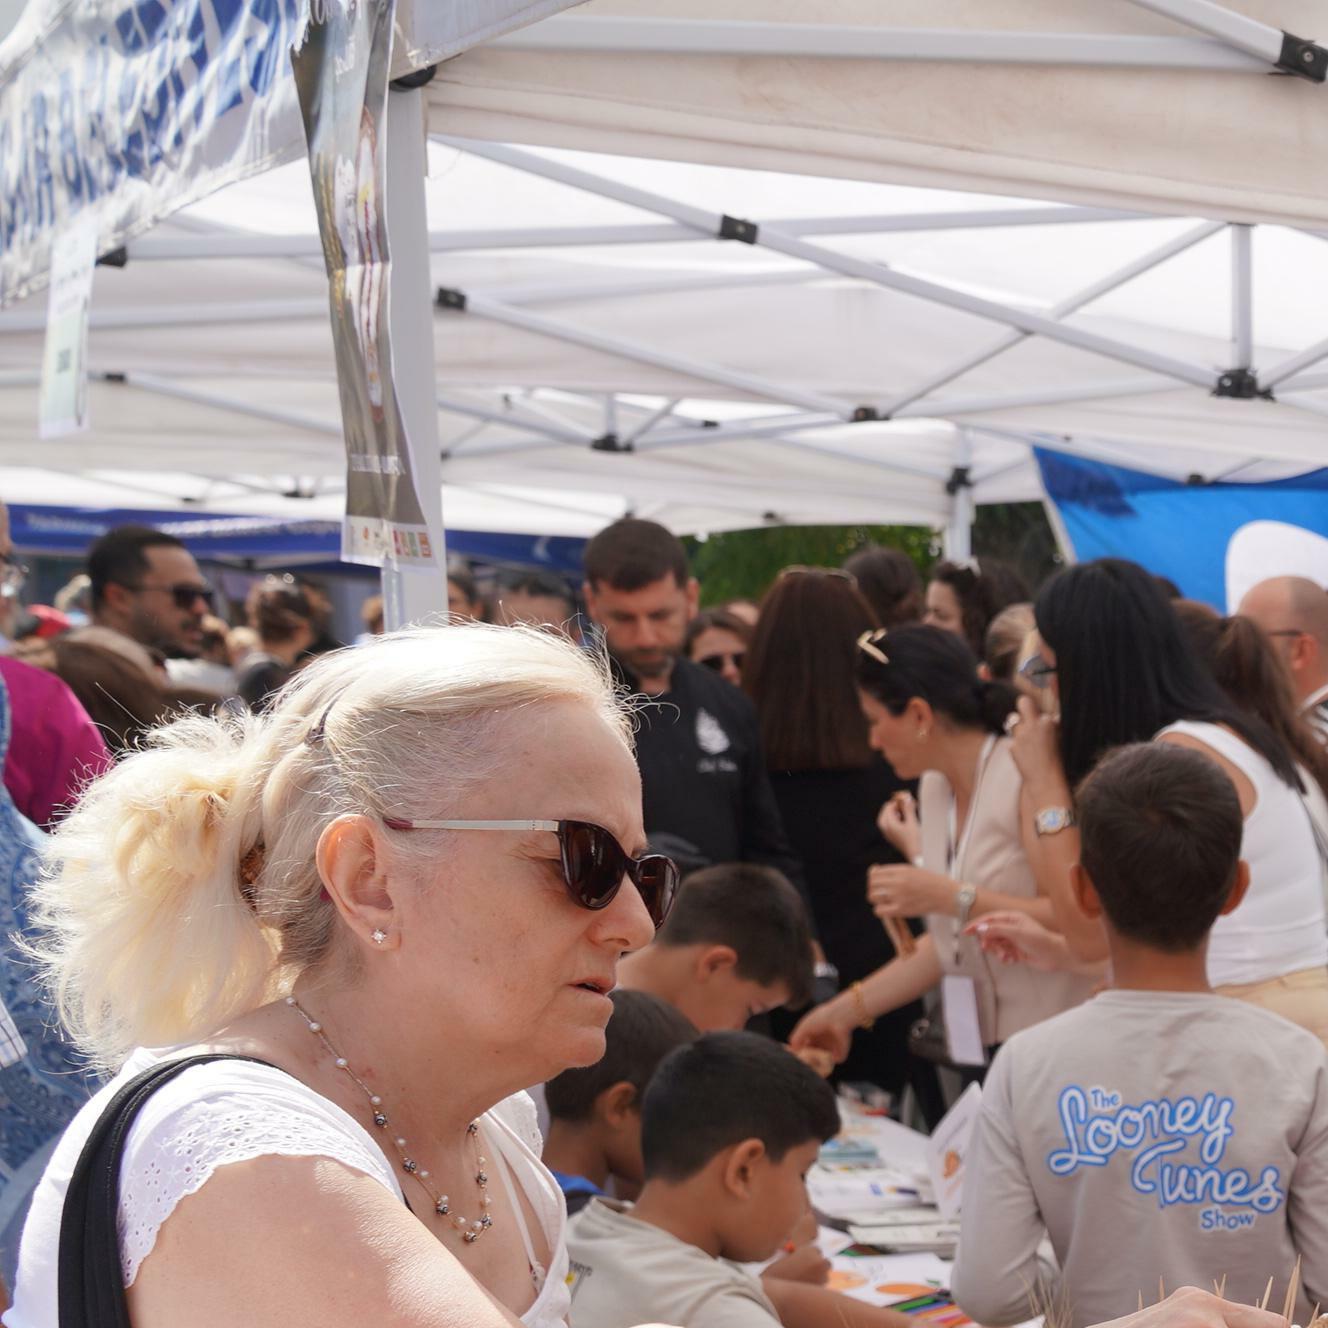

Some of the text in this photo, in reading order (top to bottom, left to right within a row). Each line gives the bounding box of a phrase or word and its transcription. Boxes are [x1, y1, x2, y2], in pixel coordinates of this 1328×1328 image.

[1090, 1088, 1121, 1109] The
[1048, 1085, 1235, 1174] Looney
[1131, 1138, 1285, 1214] Tunes
[1200, 1208, 1255, 1230] Show
